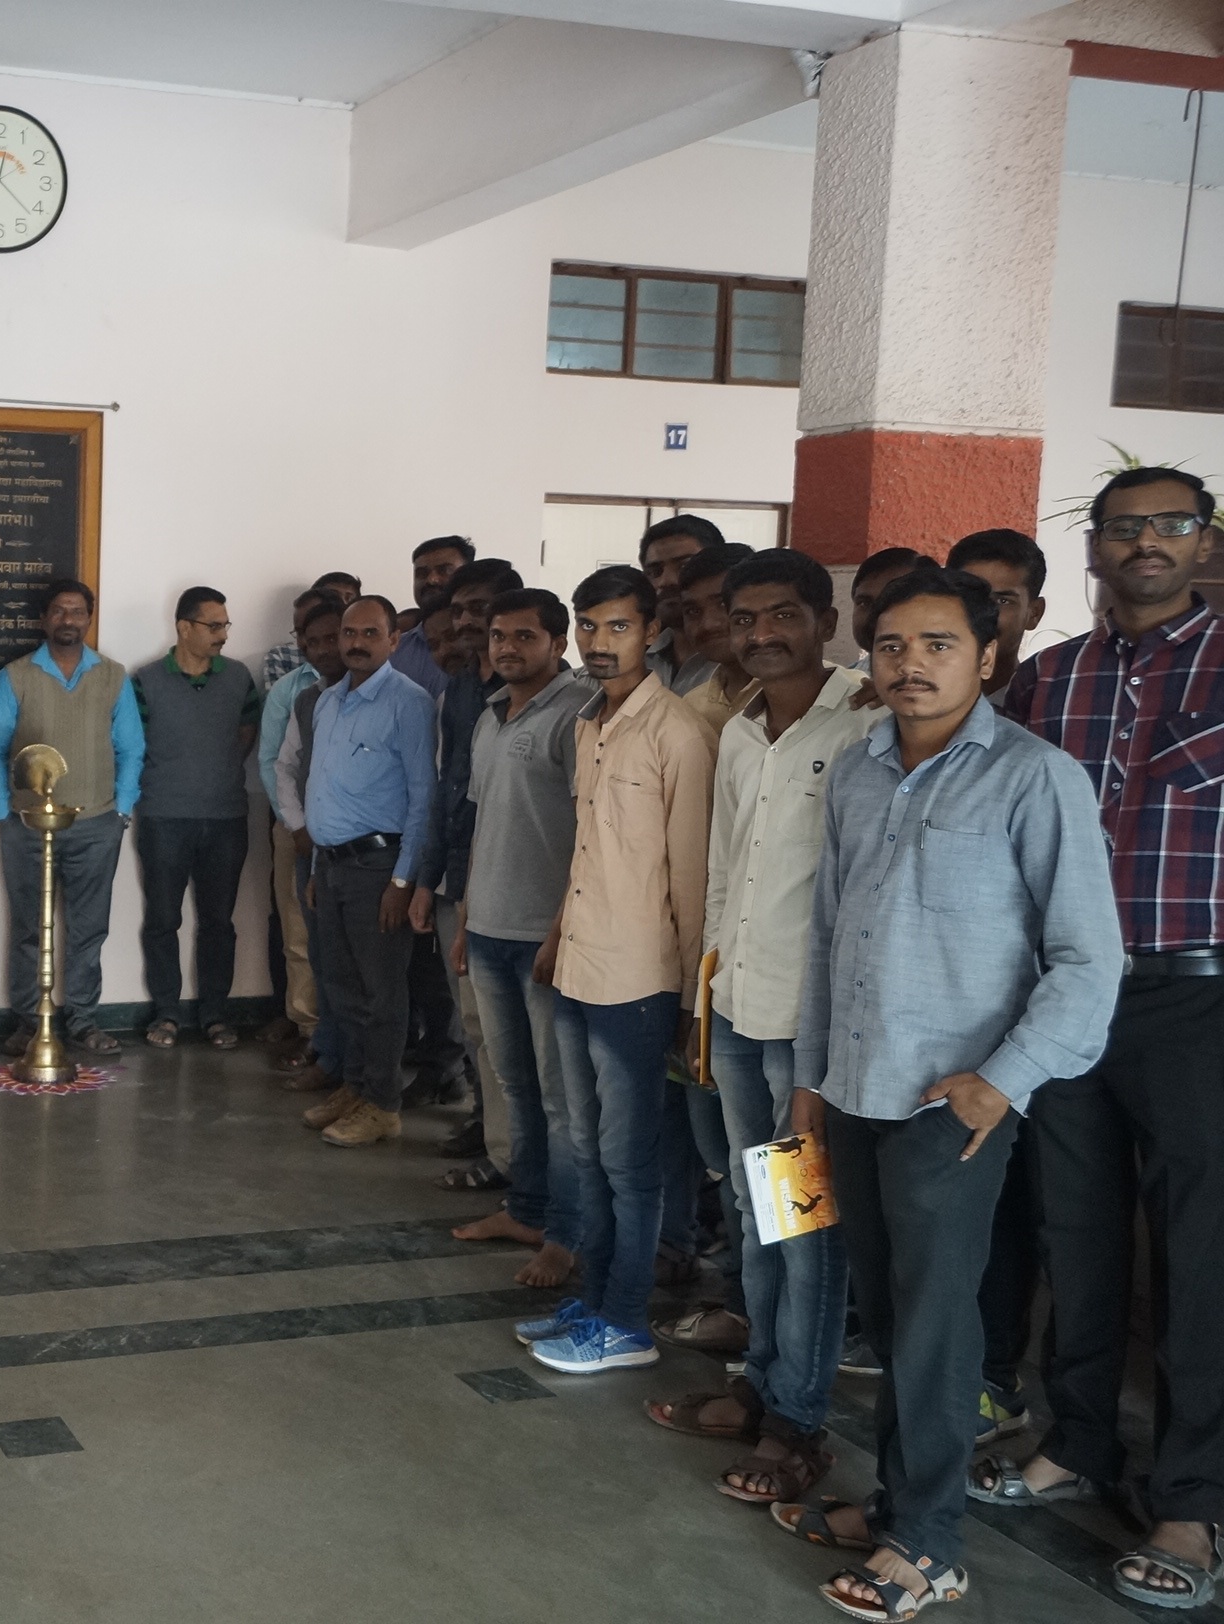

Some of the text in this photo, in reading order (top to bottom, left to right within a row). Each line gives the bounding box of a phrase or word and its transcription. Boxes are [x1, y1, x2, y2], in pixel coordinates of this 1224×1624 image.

[19, 129, 25, 145] 1
[32, 149, 46, 166] 2
[39, 175, 52, 192] 3
[31, 200, 44, 215] 4
[14, 218, 28, 234] 5
[668, 429, 687, 446] 17
[23, 558, 53, 575] साहेब
